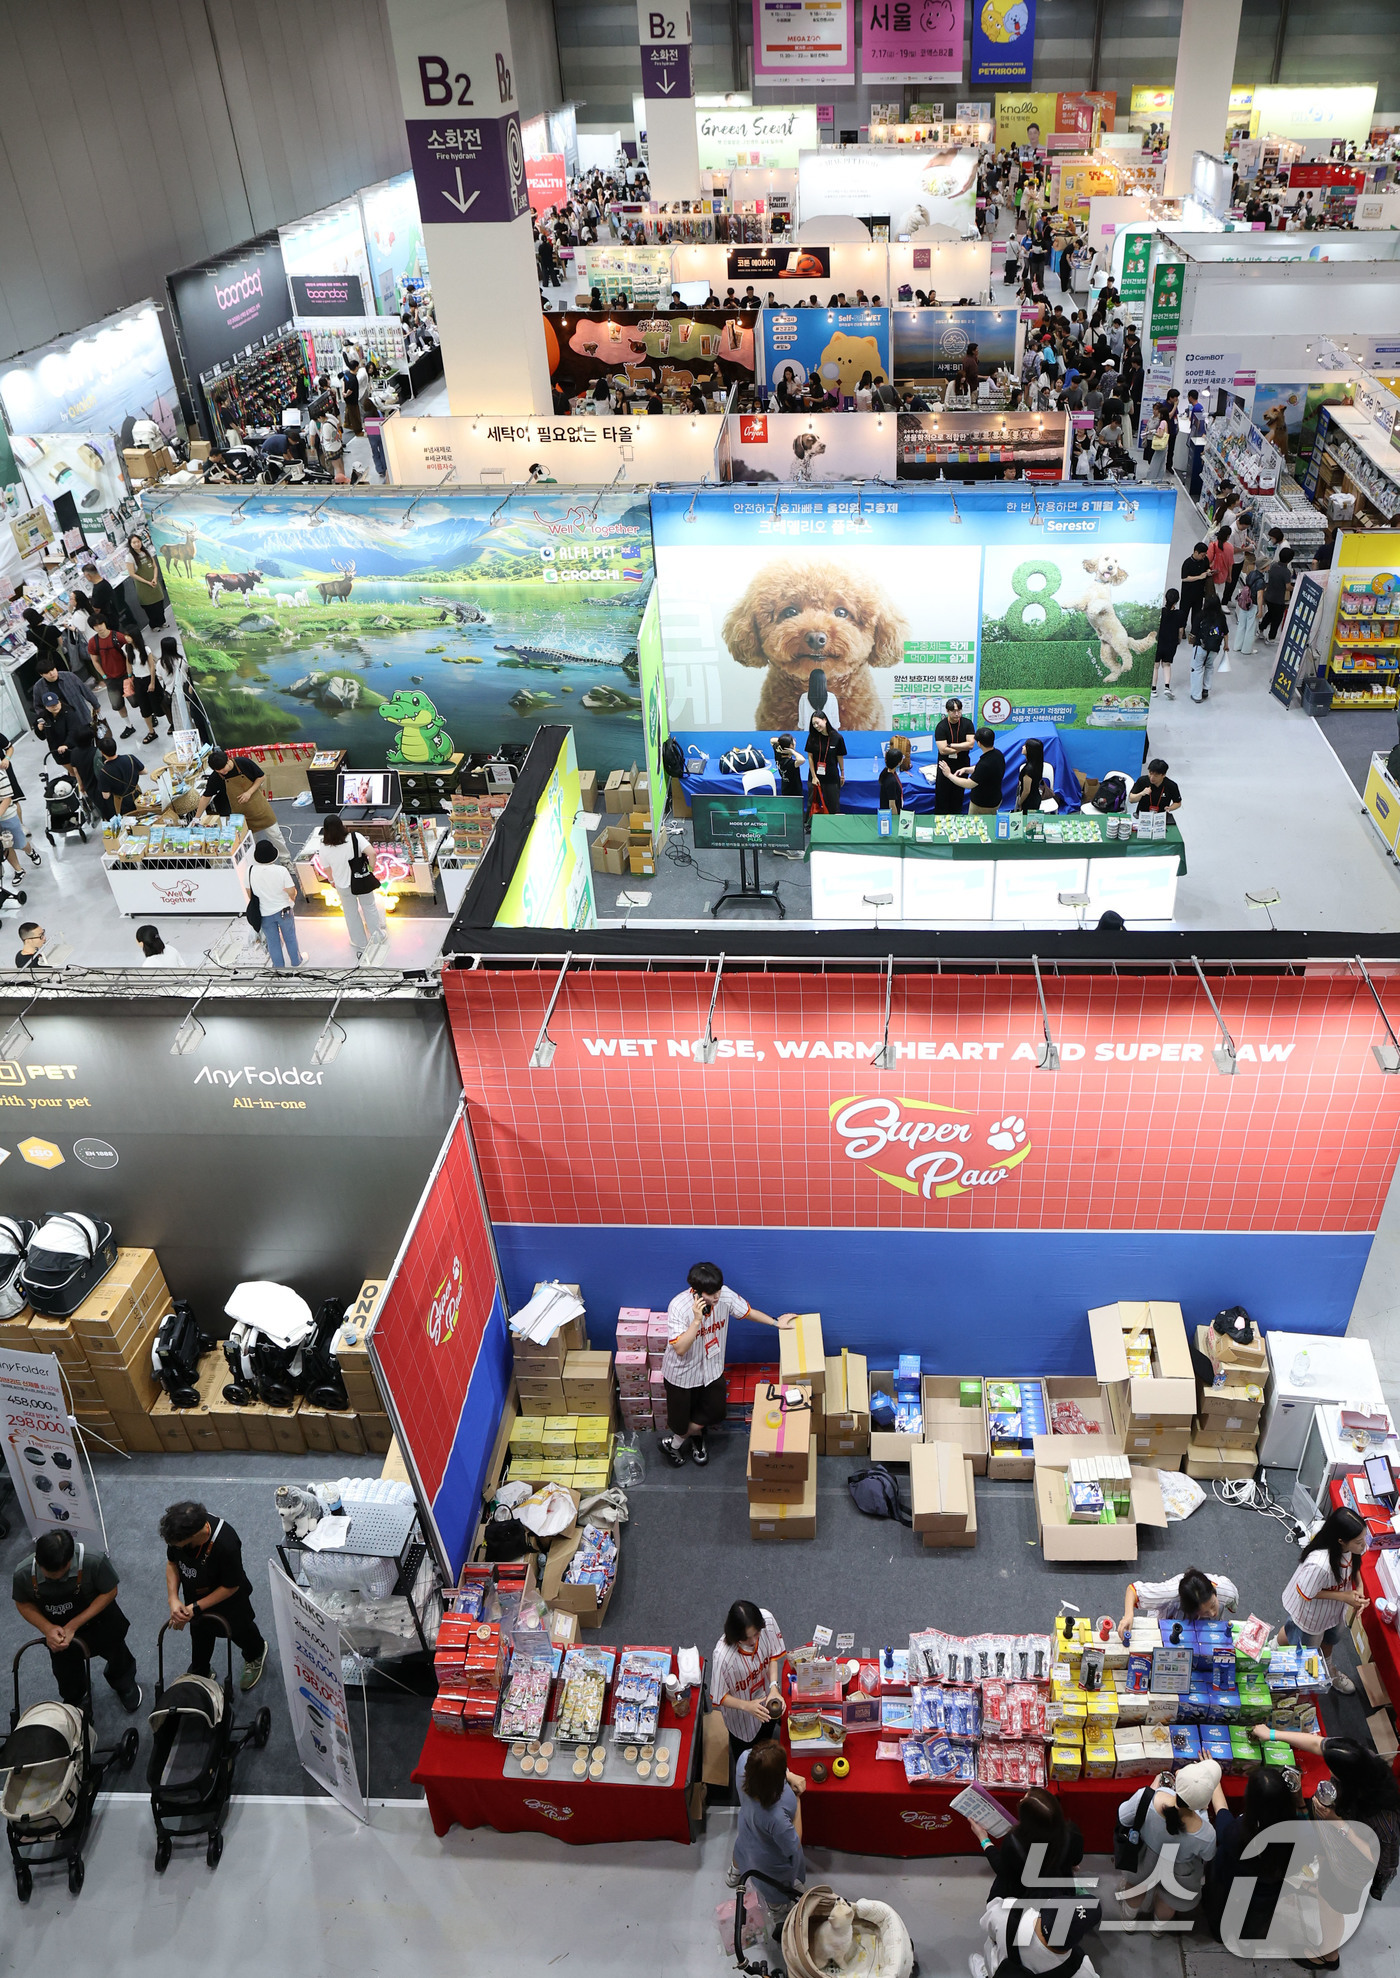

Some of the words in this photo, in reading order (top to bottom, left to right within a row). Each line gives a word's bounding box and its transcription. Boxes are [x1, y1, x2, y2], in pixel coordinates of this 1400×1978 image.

[870, 2, 911, 32] 서울
[649, 12, 676, 39] B2
[650, 49, 679, 61] 소화전
[495, 52, 513, 104] B2
[978, 67, 1027, 75] PETHROOM
[417, 55, 474, 107] B2
[701, 117, 748, 137] Green
[752, 113, 800, 136] Scent
[427, 128, 483, 151] 소화전
[487, 426, 530, 443] 세탁이
[537, 426, 597, 443] 필요없는
[603, 426, 633, 443] 타올
[733, 503, 776, 514] 안전하고
[780, 503, 823, 514] 효과빠른
[827, 503, 859, 513] 올인원
[864, 503, 899, 514] 구충제
[1006, 502, 1016, 512] 한
[1021, 502, 1031, 512] 번
[1081, 500, 1114, 511] 8개월
[549, 524, 574, 534] Well
[591, 524, 639, 537] Together
[1047, 519, 1096, 531] Seresto
[559, 546, 589, 559] ALFA
[593, 546, 616, 559] PET
[560, 569, 620, 581] CROCCHI
[910, 641, 948, 651] 구충제는
[949, 641, 969, 651] 작게
[910, 654, 948, 663] 먹이기는
[949, 654, 969, 663] 쉽게
[894, 683, 942, 693] 크레델리오
[943, 683, 972, 693] 플러스
[1277, 672, 1292, 691] 2+1
[992, 700, 1002, 714] 8
[1032, 714, 1065, 722] 산책하세요!
[160, 896, 197, 905] Together
[164, 889, 184, 898] Well
[582, 1038, 658, 1057] WET
[773, 1040, 883, 1060] WARM
[895, 1040, 1004, 1060] HEART
[1010, 1041, 1085, 1061] AD
[1094, 1042, 1203, 1062] SUPER
[28, 1064, 78, 1081] PET
[193, 1065, 325, 1088] AnyFolder
[27, 1097, 63, 1110] your
[68, 1095, 92, 1110] pet
[232, 1097, 307, 1110] All-in-one
[835, 1097, 973, 1160] Super
[905, 1150, 1009, 1200] Paw
[428, 1279, 452, 1346] Super
[291, 1590, 326, 1626] PLIKO
[523, 1798, 559, 1812] Super
[544, 1809, 571, 1821] Paw
[900, 1810, 937, 1824] Super
[920, 1819, 948, 1831] Paw
